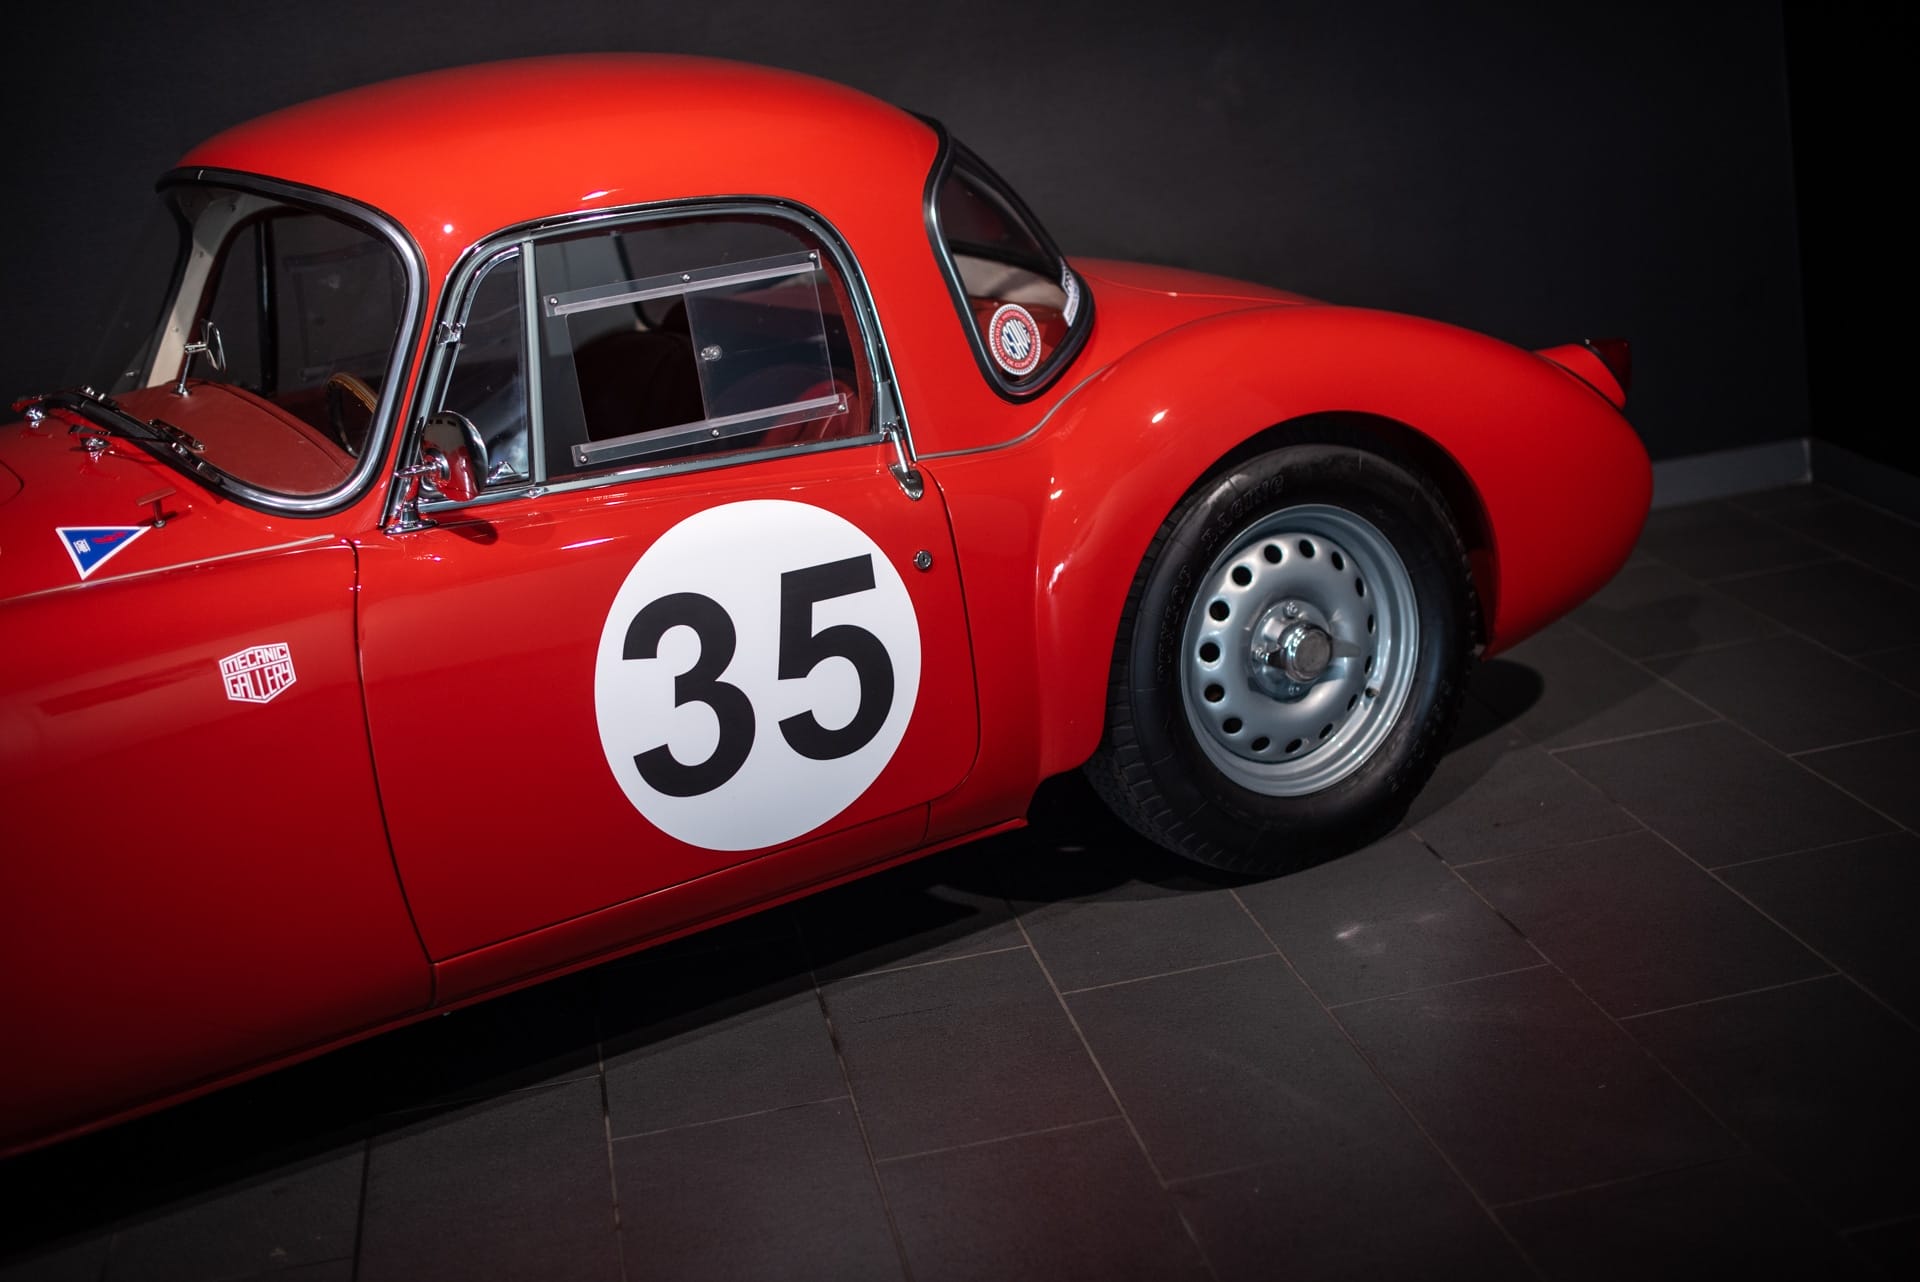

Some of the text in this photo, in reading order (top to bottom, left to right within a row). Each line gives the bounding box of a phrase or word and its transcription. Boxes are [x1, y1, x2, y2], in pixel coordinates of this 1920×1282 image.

[223, 646, 288, 675] MECANIC
[622, 553, 895, 798] 35
[226, 661, 291, 700] GALLERY
